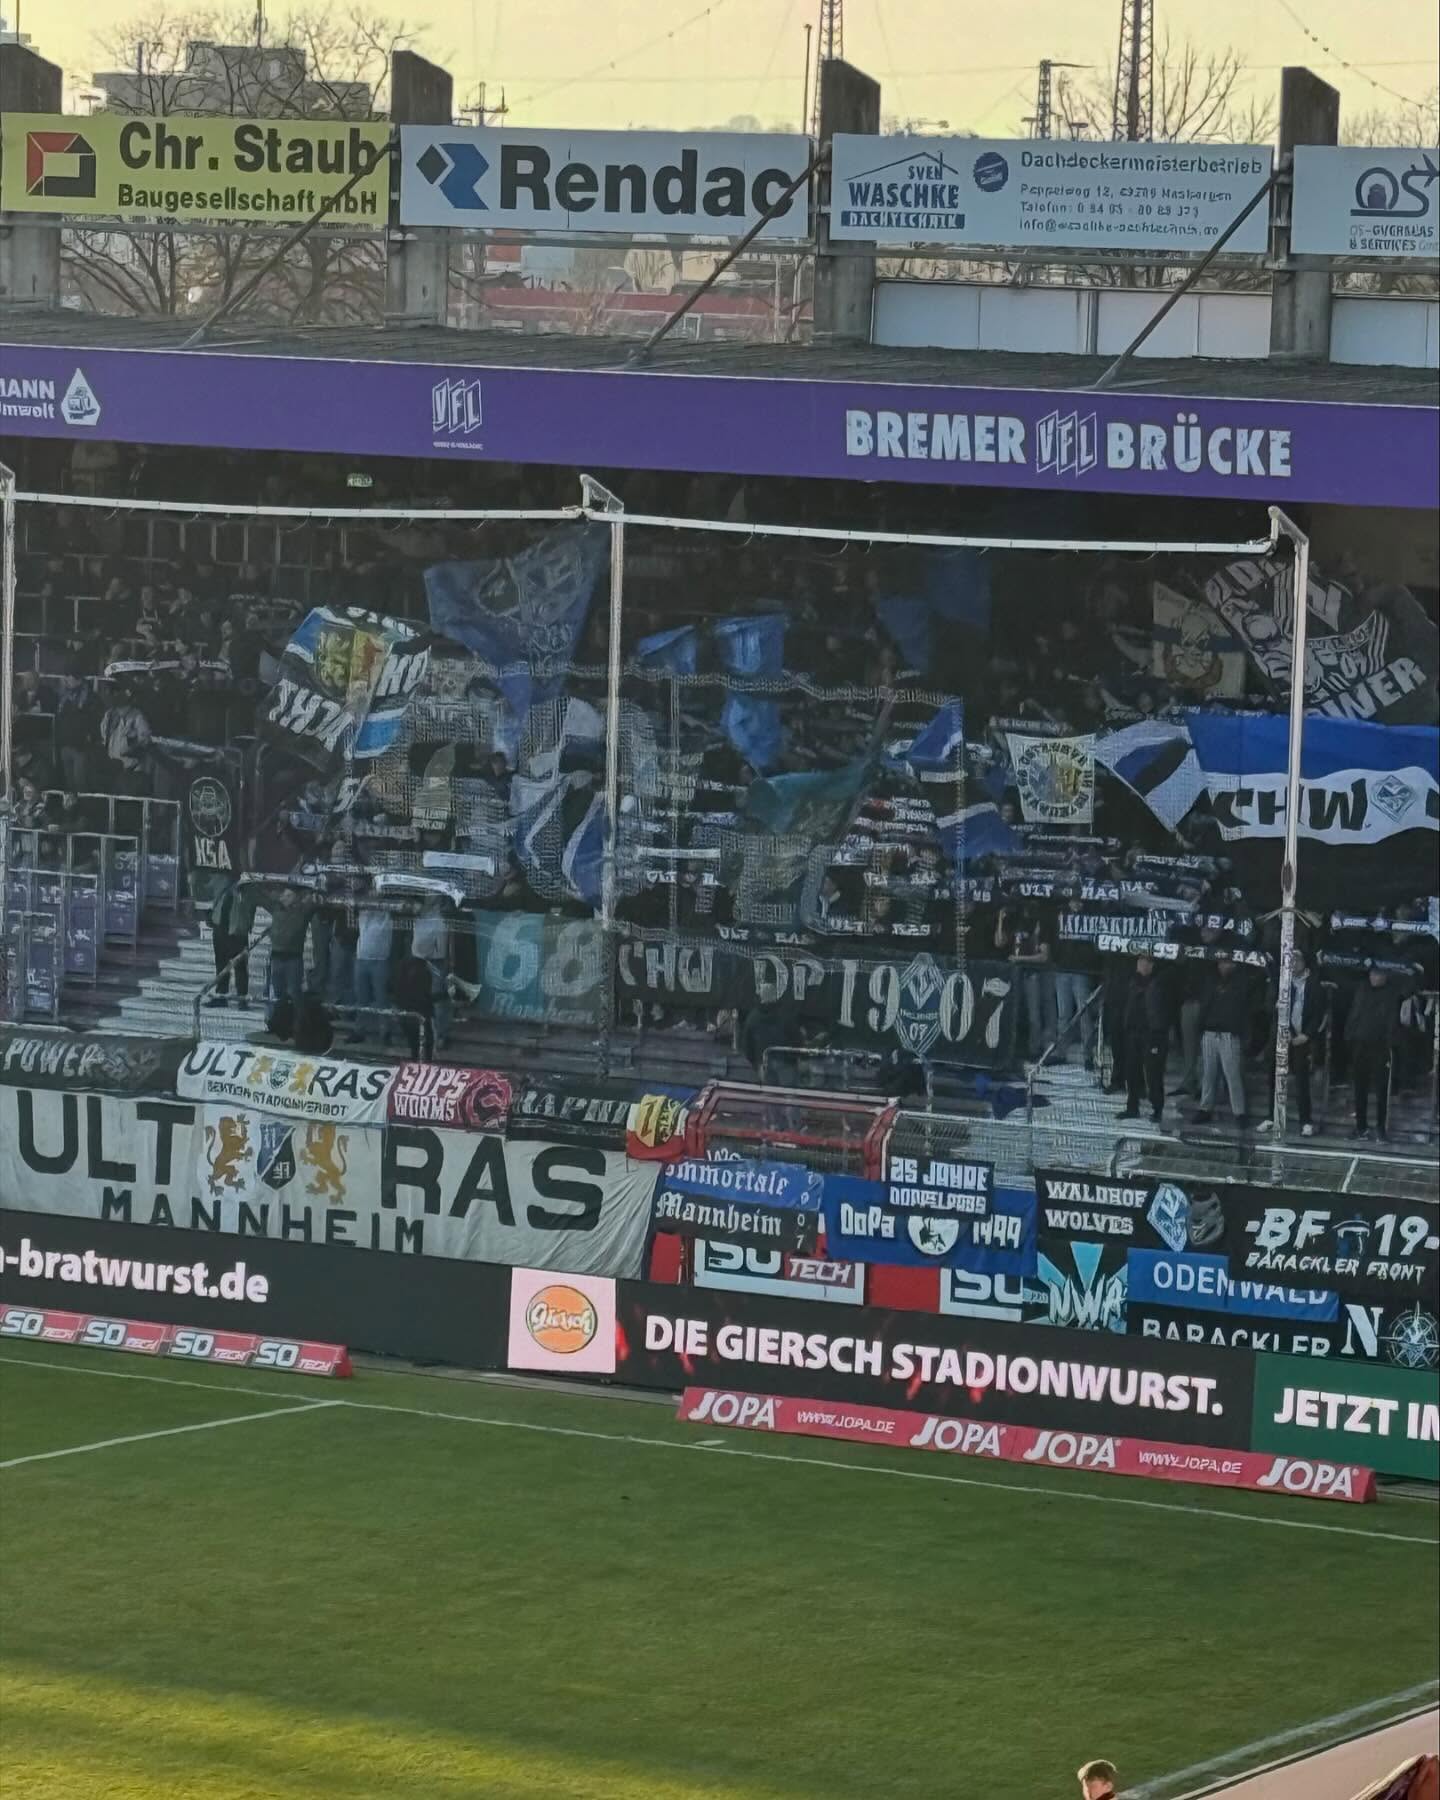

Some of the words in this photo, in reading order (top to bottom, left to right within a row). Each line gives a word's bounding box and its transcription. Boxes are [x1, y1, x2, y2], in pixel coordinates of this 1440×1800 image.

[119, 121, 219, 170] Chr.
[234, 123, 377, 175] Staub
[118, 184, 316, 214] Baugesellschaft
[319, 191, 377, 214] mbH
[500, 144, 795, 218] Rendac
[849, 182, 959, 209] WASCHKE
[846, 410, 1027, 464] BREMER
[1107, 412, 1292, 477] BRÜCKE
[3, 1037, 102, 1077] POWER
[184, 1047, 256, 1079] ULT
[308, 1065, 392, 1100] RAS
[394, 1092, 457, 1121] WORMS
[17, 1089, 196, 1185] ULT
[381, 1126, 607, 1231] RAS
[655, 1191, 782, 1236] Mannheim
[1045, 1180, 1149, 1209] WALDHOF
[102, 1186, 424, 1255] MANNHEIM
[1045, 1209, 1134, 1236] WOLVES
[788, 1257, 852, 1284] TECH
[1366, 1261, 1426, 1285] FRONT
[82, 1321, 126, 1345] SO
[171, 1332, 215, 1357] SO
[256, 1342, 299, 1367] SO
[646, 1315, 708, 1356] DIE
[716, 1324, 882, 1376] GIERSCH
[891, 1343, 1224, 1416] STADIONWURST.
[1274, 1388, 1399, 1436] JETZT
[688, 1391, 776, 1429] JOPA
[910, 1417, 1003, 1456] JOPA
[1023, 1430, 1117, 1468] JOPA
[1257, 1458, 1354, 1498] JOPA
